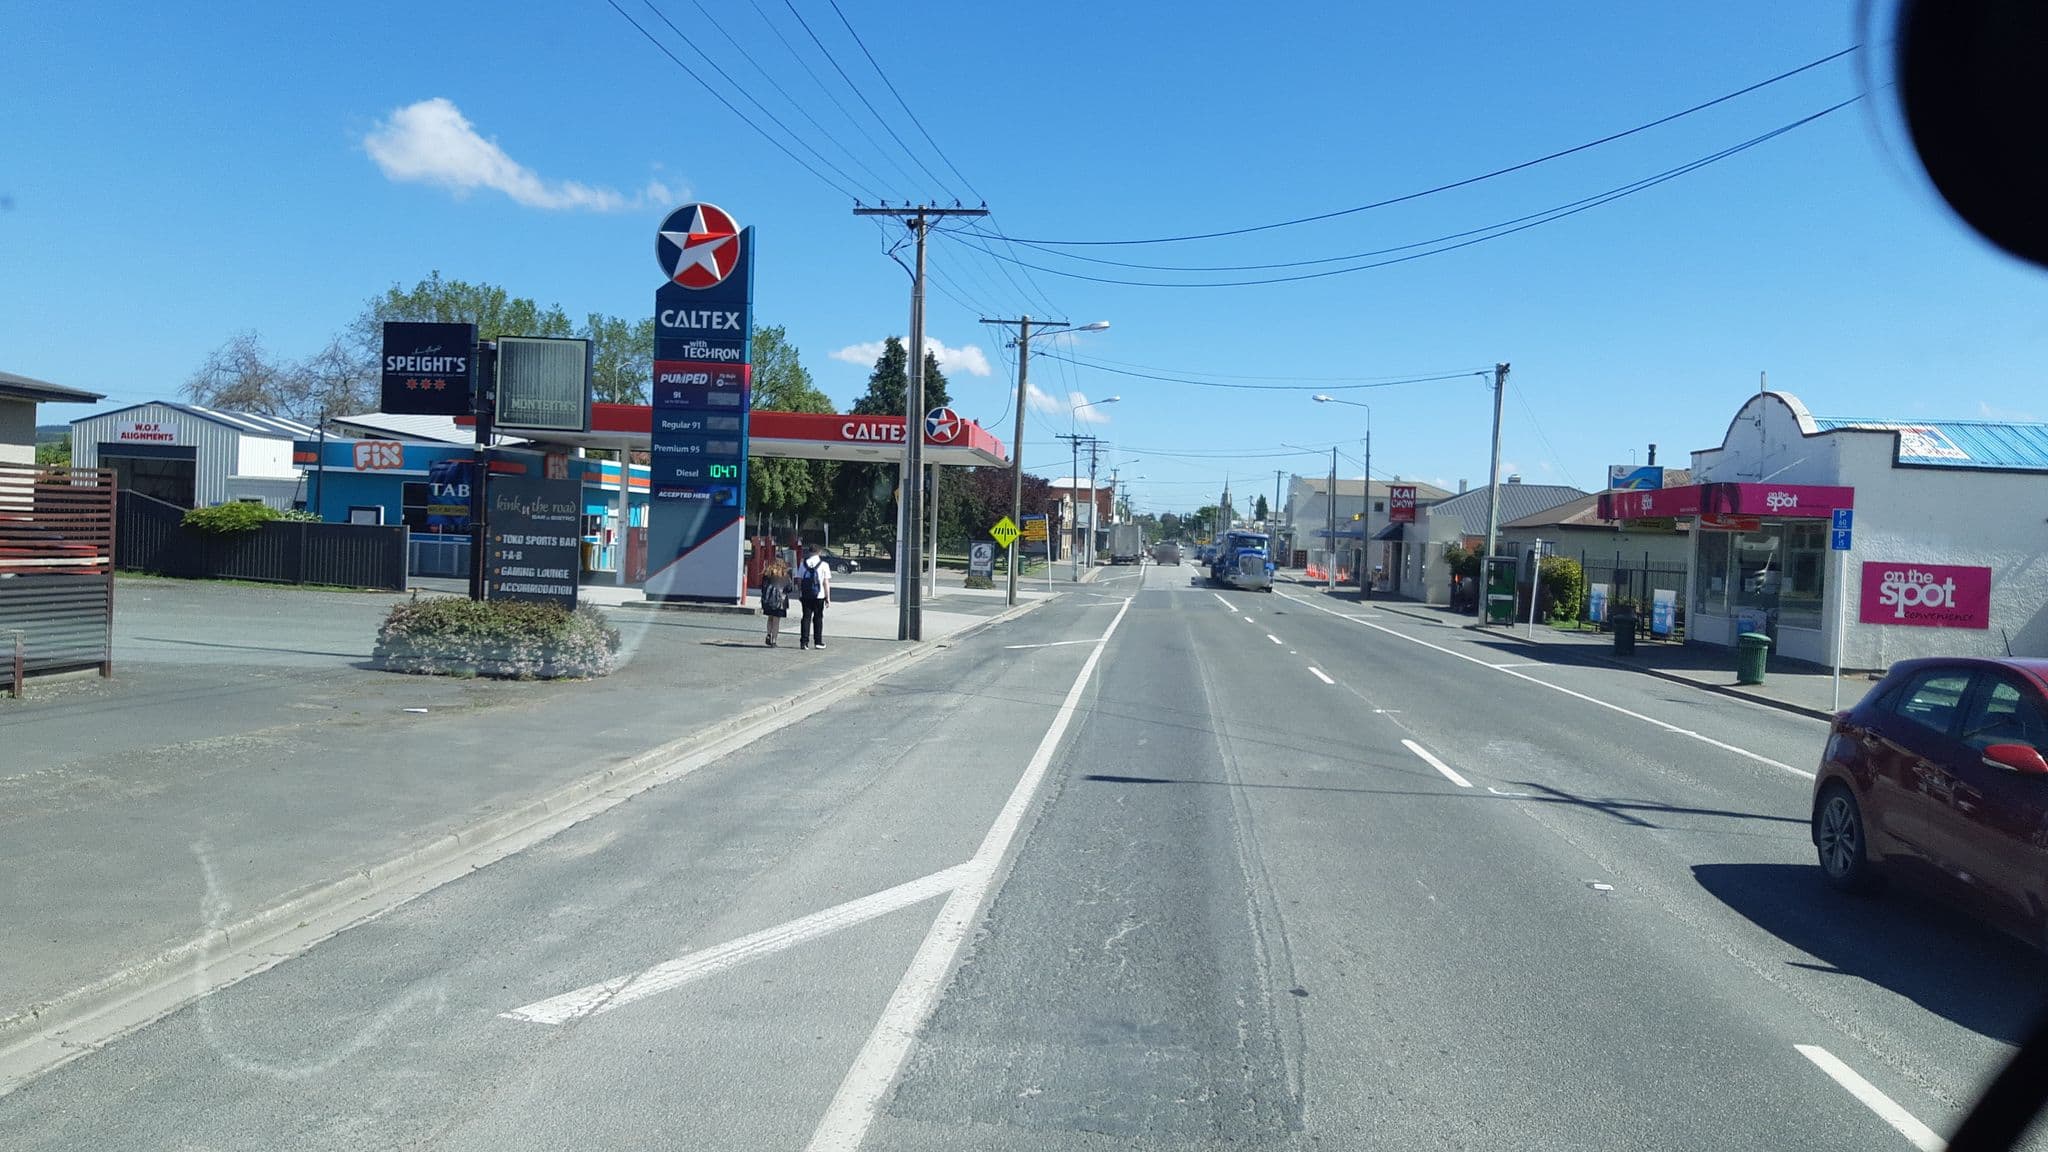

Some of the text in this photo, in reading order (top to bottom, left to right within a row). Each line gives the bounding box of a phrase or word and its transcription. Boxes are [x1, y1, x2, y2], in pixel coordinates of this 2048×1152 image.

[660, 309, 741, 330] CALTEX
[689, 340, 707, 348] with
[683, 345, 740, 361] TECHRON
[386, 355, 466, 372] SPEIGHT'S
[660, 373, 708, 385] PUMPED
[661, 420, 701, 431] Regular 91
[120, 432, 174, 441] ALIGNMENTS
[654, 444, 701, 454] Premium 95
[675, 469, 699, 478] Diesel
[430, 482, 471, 498] TAB
[658, 491, 693, 499] ACCEPTED
[1393, 488, 1415, 499] KAI
[497, 495, 521, 512] kink
[531, 496, 549, 512] the
[552, 501, 576, 513] road
[1766, 494, 1798, 512] spot
[1839, 510, 1847, 519] P
[525, 535, 557, 546] SPORTS
[559, 536, 577, 547] BAR
[1838, 531, 1846, 540] P
[501, 566, 570, 579] GAMING LOUNGE
[1884, 569, 1934, 584] on the
[500, 582, 573, 595] ACCOMMODATION
[1880, 577, 1956, 618] spot
